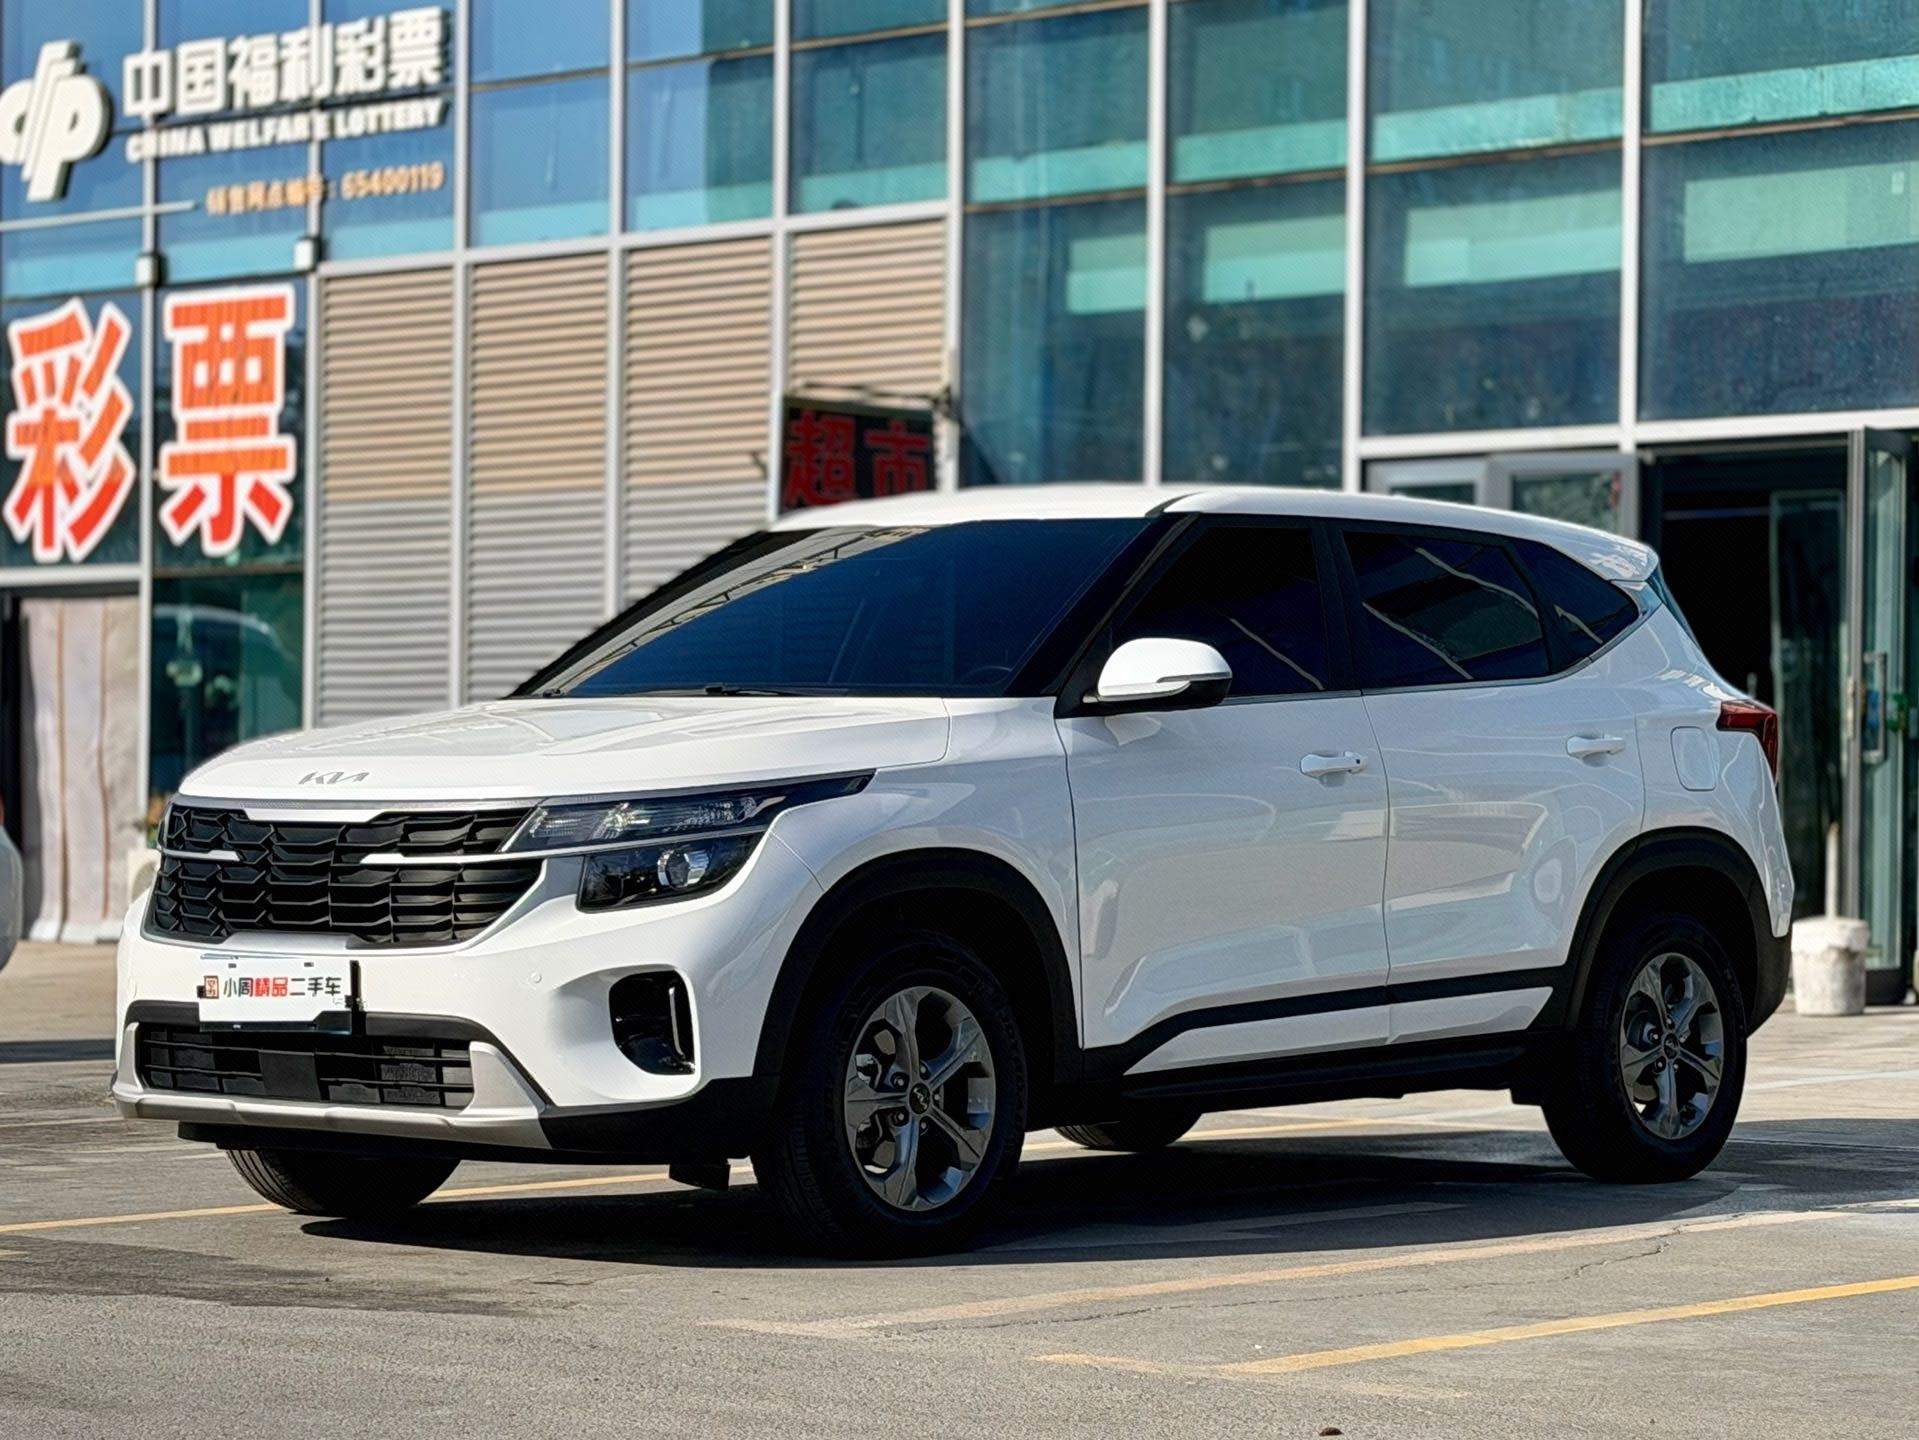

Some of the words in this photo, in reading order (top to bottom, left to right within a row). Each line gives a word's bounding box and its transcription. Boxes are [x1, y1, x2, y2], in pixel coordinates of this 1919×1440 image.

[122, 6, 442, 119] 中国福利彩票
[125, 128, 204, 163] CHINA
[209, 112, 328, 152] WELFARE
[336, 98, 443, 138] LOTTERY
[3, 283, 297, 563] 彩票
[784, 409, 931, 506] 超市
[298, 771, 370, 784] KIA
[223, 976, 342, 997] 小周精品二手车
